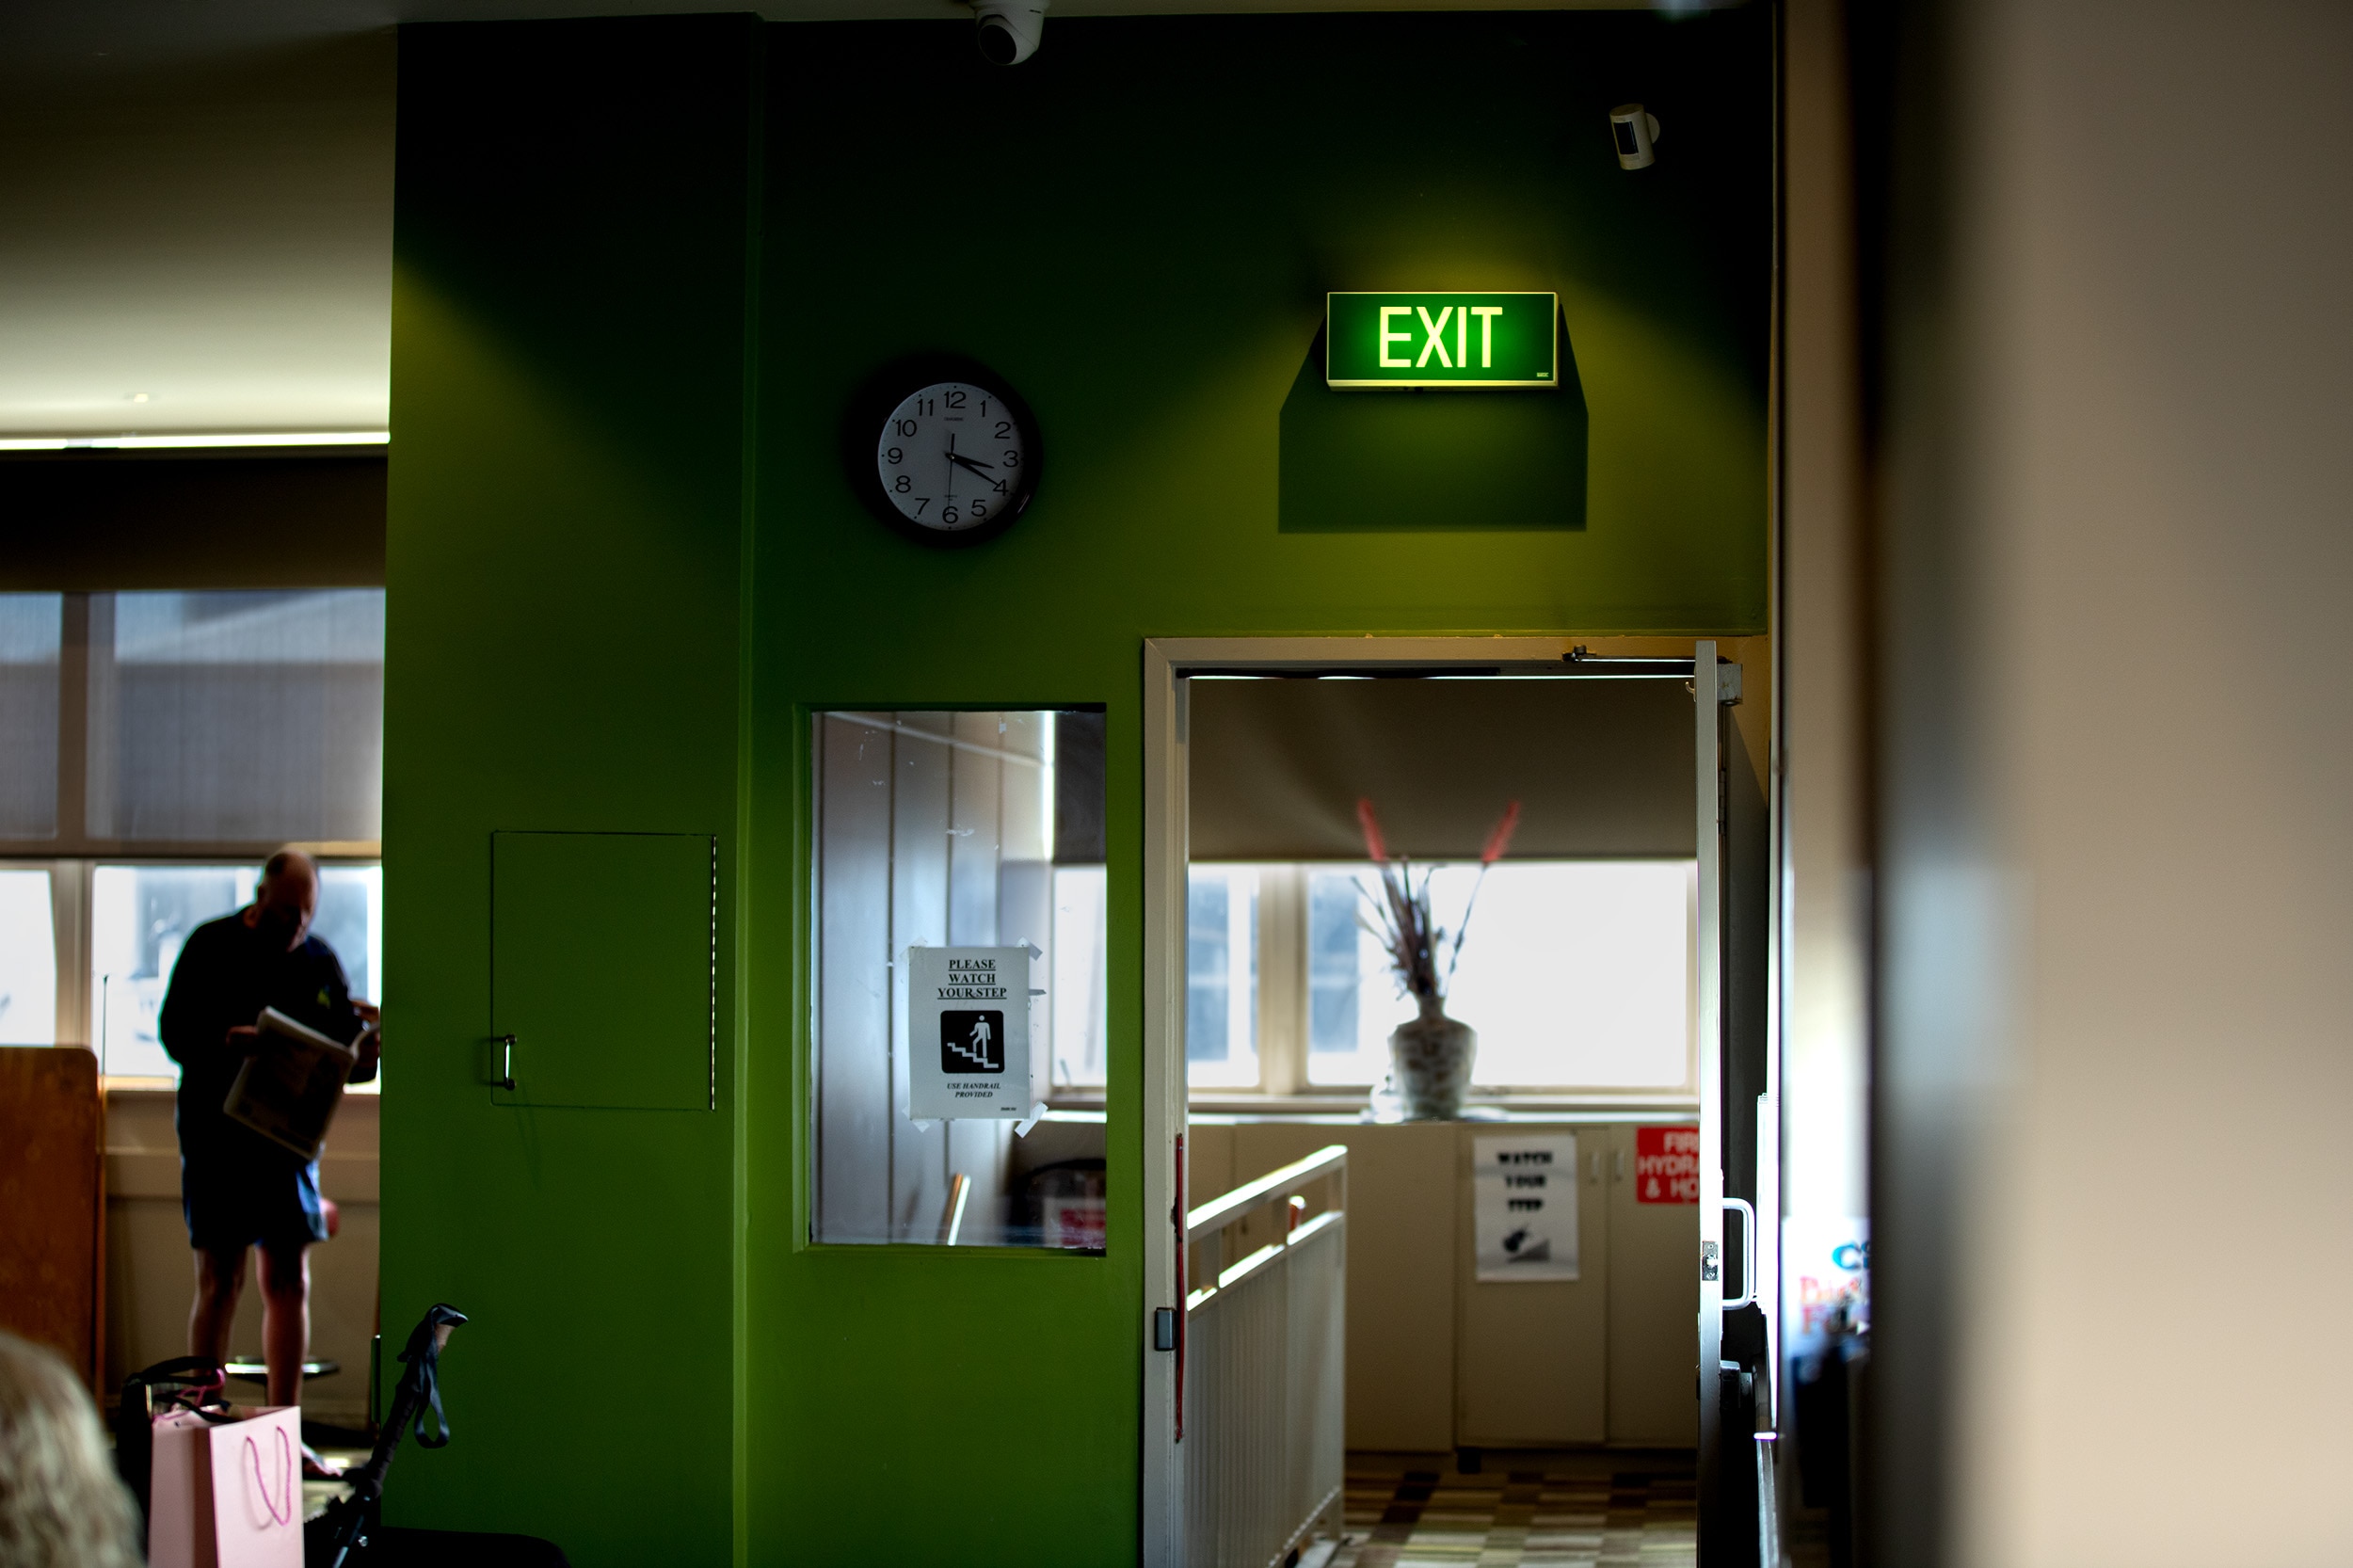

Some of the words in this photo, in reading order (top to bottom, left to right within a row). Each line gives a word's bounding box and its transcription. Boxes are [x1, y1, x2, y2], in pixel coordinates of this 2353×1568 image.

[1379, 306, 1503, 368] EXIT
[917, 399, 934, 416] 11
[944, 391, 967, 408] 12
[980, 400, 986, 417] 1
[896, 419, 918, 438] 10
[995, 421, 1011, 439] 2
[888, 447, 903, 464] 9
[1003, 450, 1018, 468] 3
[895, 475, 911, 493] 8
[993, 479, 1009, 496] 4
[915, 498, 930, 515] 7
[942, 505, 958, 523] 6
[971, 499, 986, 517] 5
[949, 959, 996, 969] PLEASE
[949, 973, 996, 984] WATCH
[937, 987, 973, 998] YOUR
[976, 987, 1007, 998] STEP
[1663, 1131, 1699, 1153] FIR
[1638, 1154, 1699, 1176] HYDRA
[1670, 1177, 1699, 1199] HO
